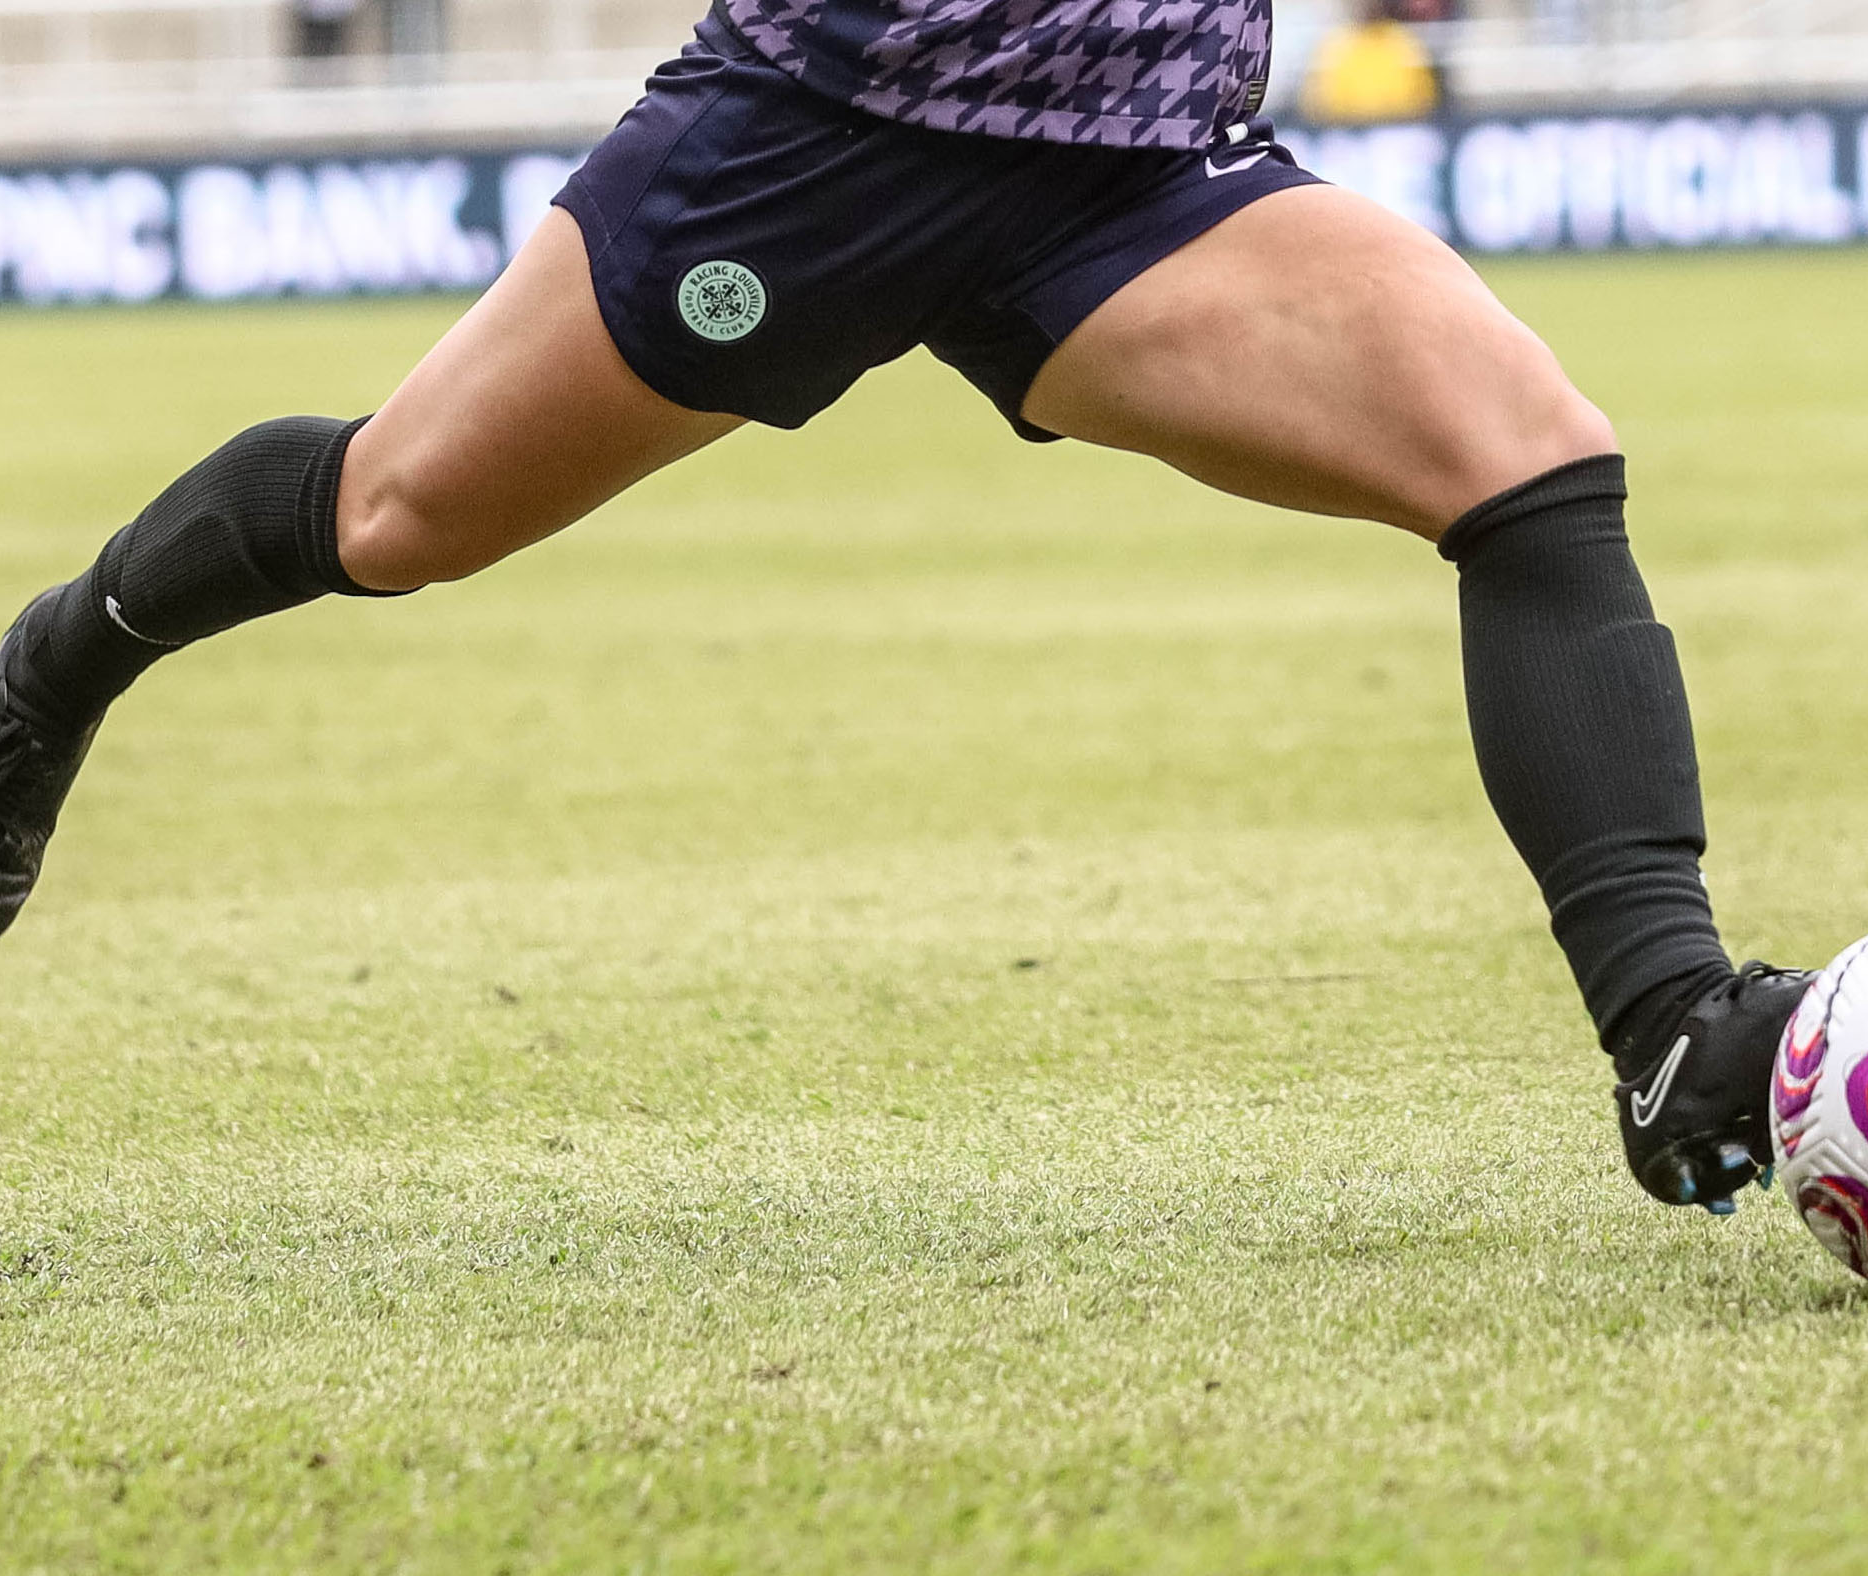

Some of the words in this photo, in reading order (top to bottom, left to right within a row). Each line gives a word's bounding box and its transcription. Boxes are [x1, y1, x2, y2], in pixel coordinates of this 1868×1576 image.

[1454, 114, 1852, 247] OFFICIAL
[685, 290, 715, 334] FOOTBALL
[719, 322, 745, 335] CLUB
[689, 265, 729, 287] RACING
[732, 269, 761, 323] LOUISVILLE
